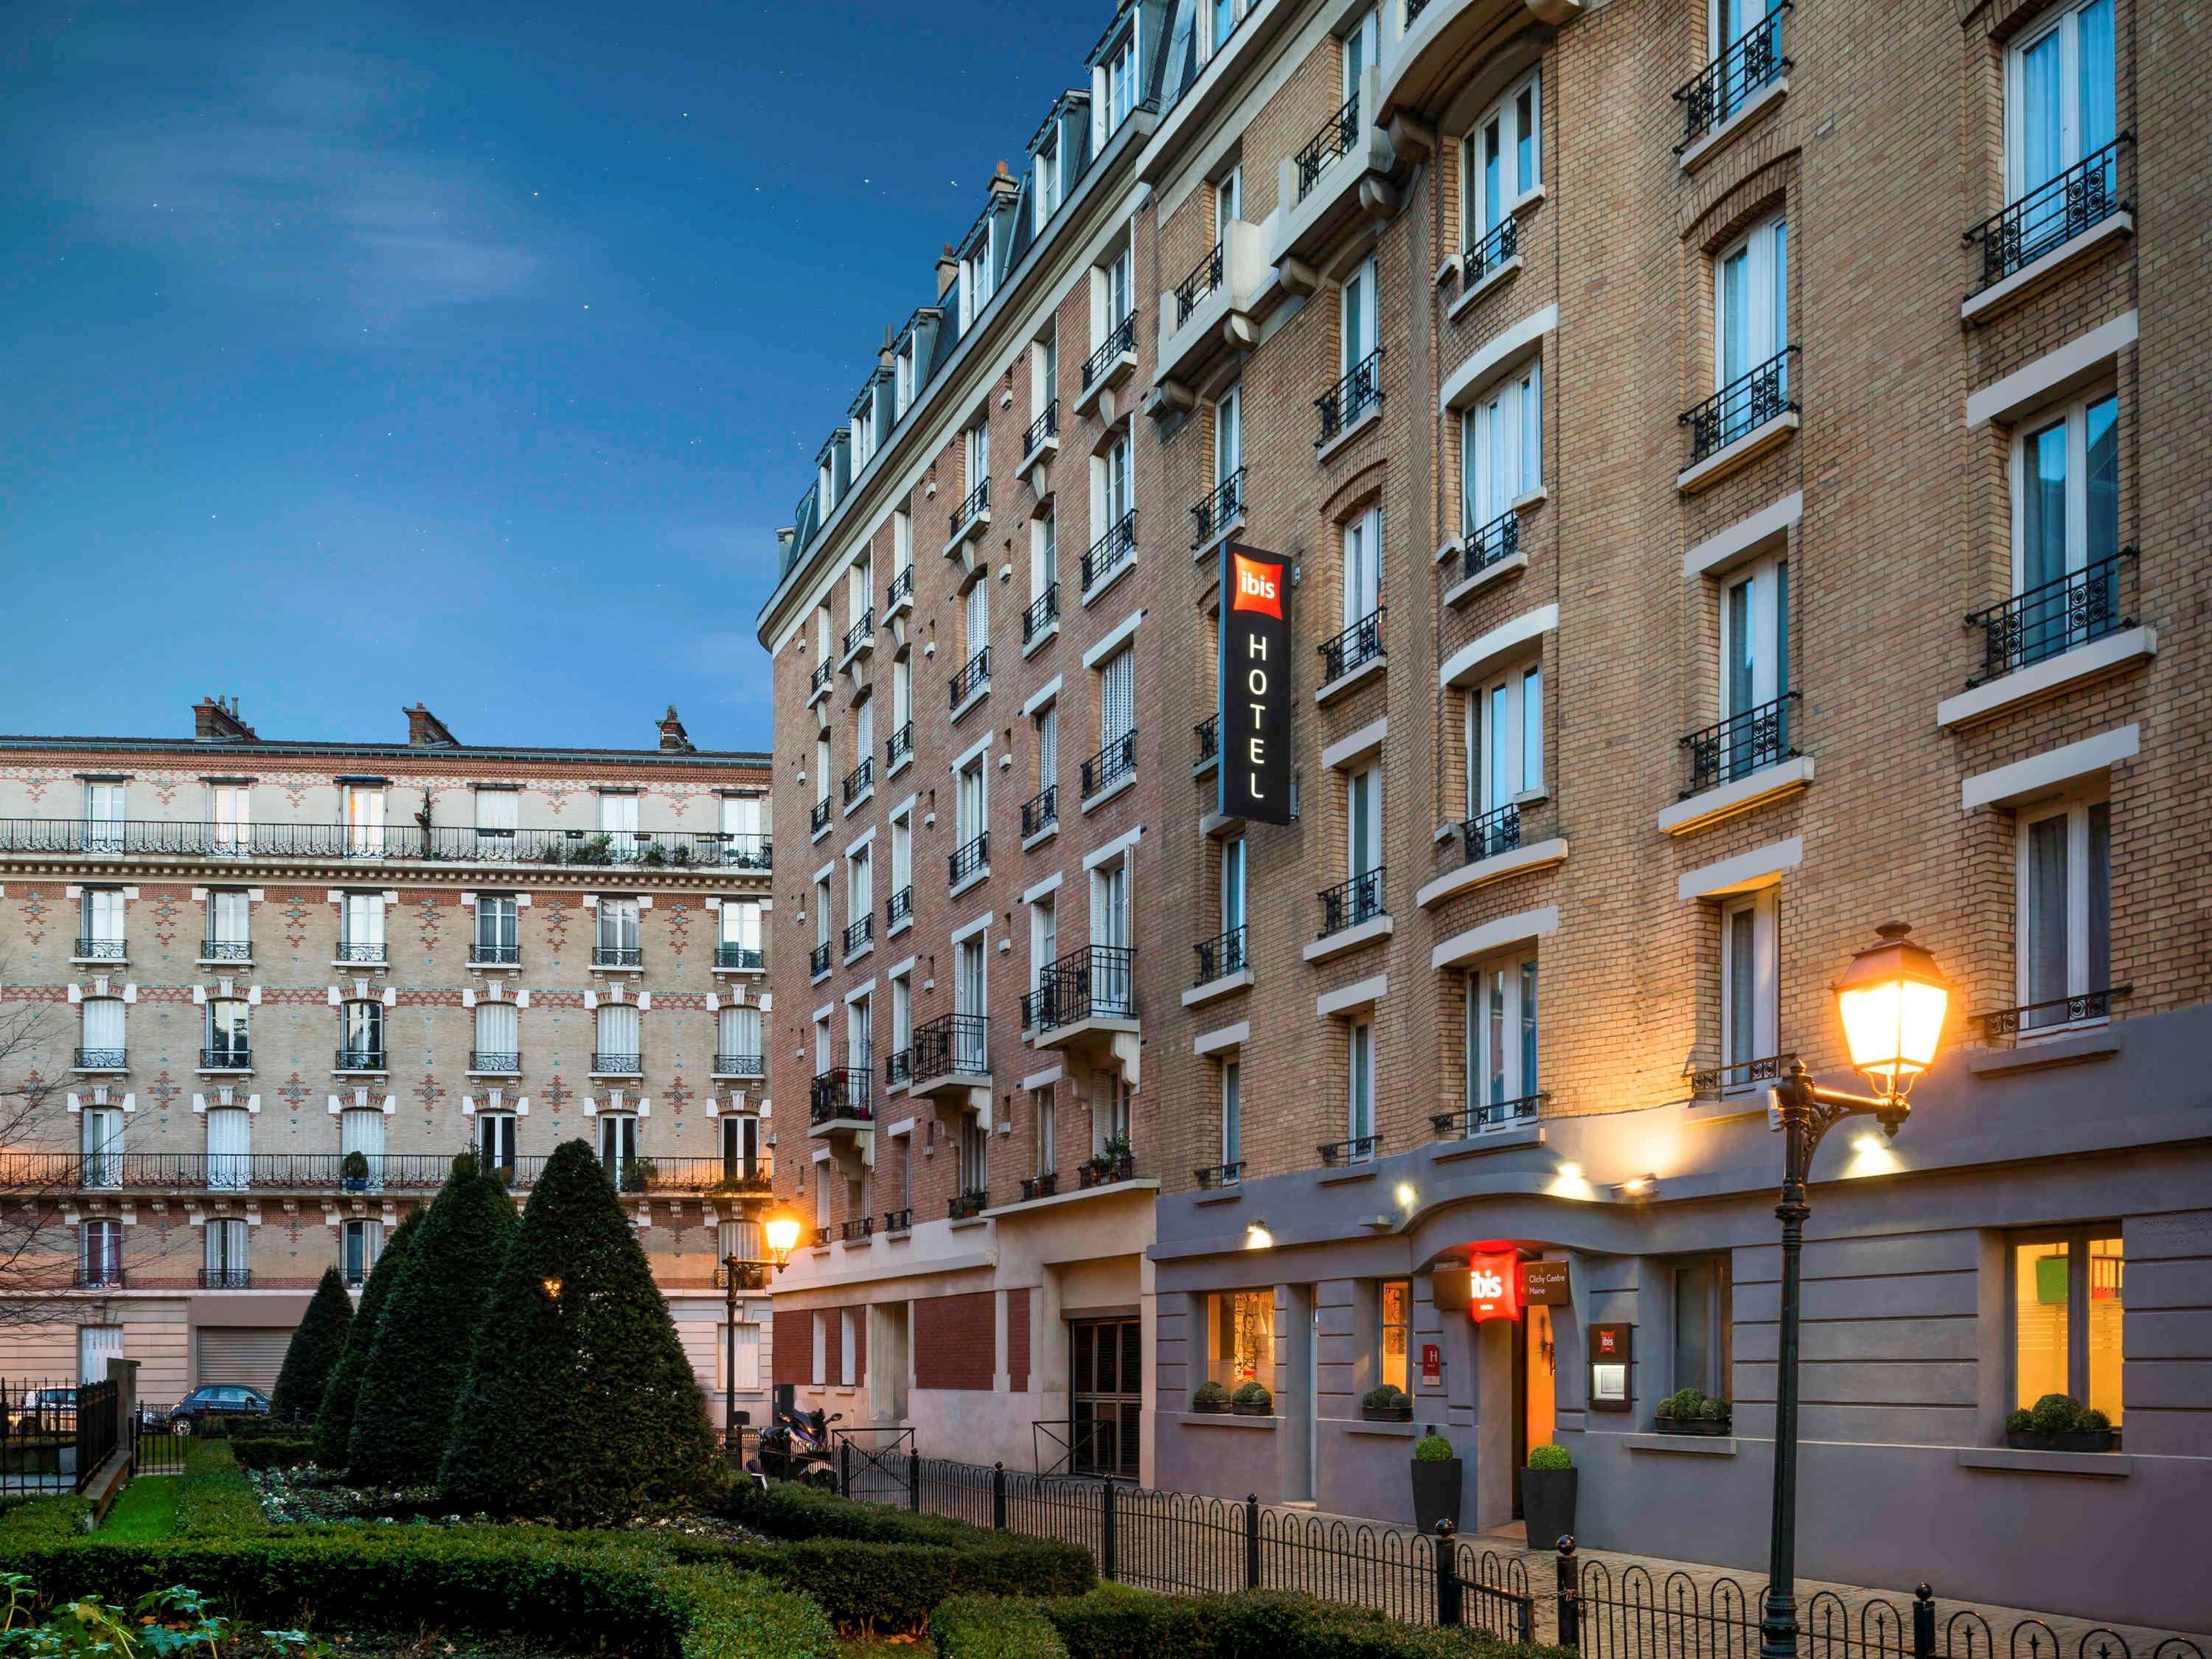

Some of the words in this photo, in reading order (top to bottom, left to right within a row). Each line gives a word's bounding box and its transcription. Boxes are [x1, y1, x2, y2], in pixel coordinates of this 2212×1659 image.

[1241, 571, 1275, 599] ibis
[1248, 633, 1267, 799] HOTEL
[1471, 1270, 1502, 1298] ibis
[1528, 1274, 1545, 1284] Clichy
[1546, 1274, 1565, 1282] Centre
[1602, 1336, 1613, 1346] ibis
[1430, 1350, 1438, 1363] H
